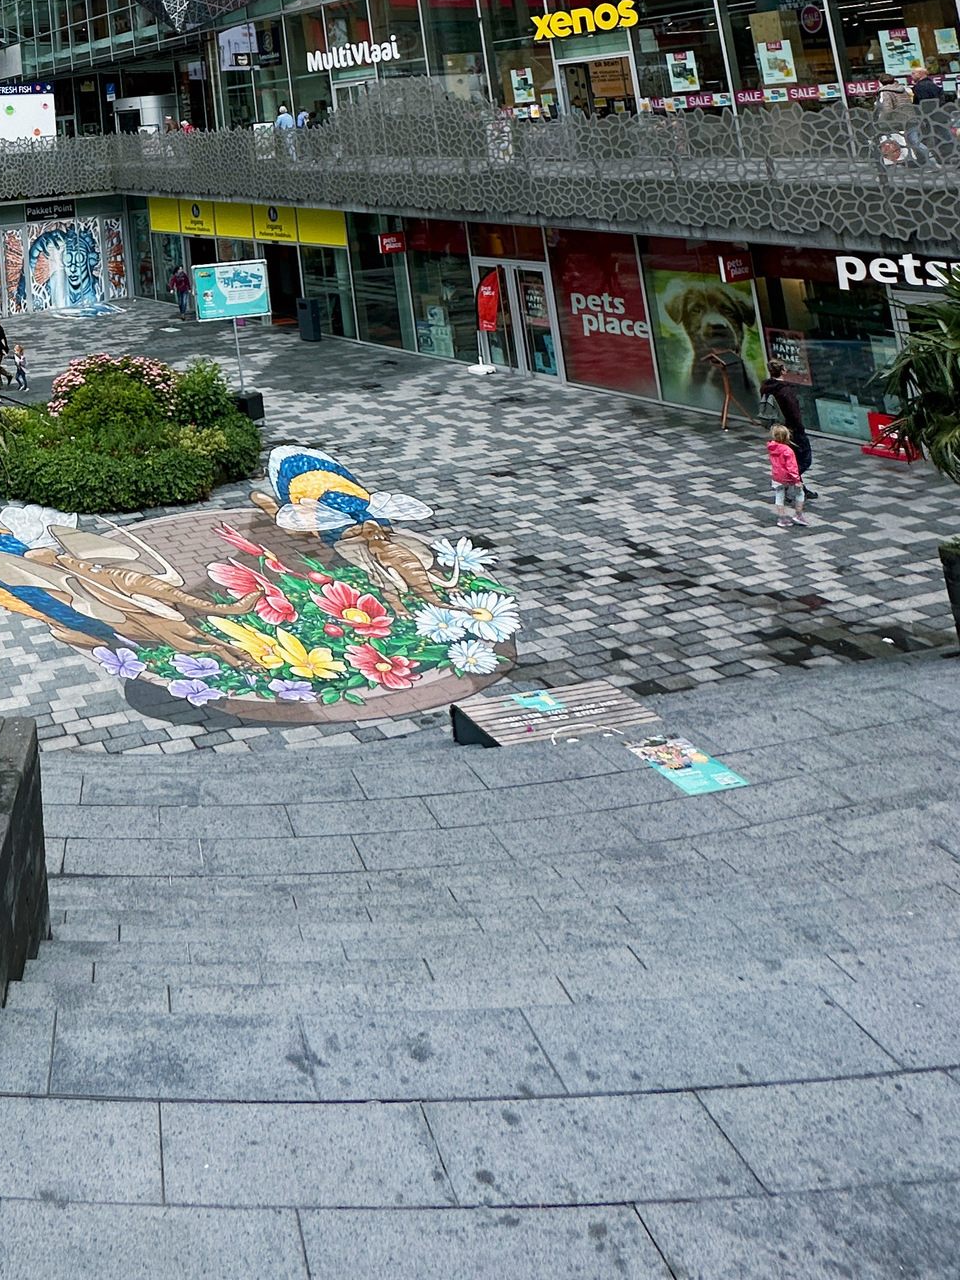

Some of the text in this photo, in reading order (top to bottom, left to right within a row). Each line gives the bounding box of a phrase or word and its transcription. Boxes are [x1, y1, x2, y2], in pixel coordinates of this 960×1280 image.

[530, 0, 639, 41] xenos
[306, 35, 400, 73] MultiVlaai
[19, 85, 32, 93] FISH
[791, 87, 816, 99] SALE
[847, 82, 877, 94] SALE
[689, 96, 710, 106] SALE
[737, 91, 761, 103] SALE
[27, 205, 73, 216] Pakket Point
[726, 258, 743, 270] pets
[730, 264, 750, 278] place
[570, 292, 626, 315] pets
[582, 313, 649, 338] place
[772, 343, 800, 355] HAPPY
[776, 353, 800, 363] PLACE
[574, 708, 607, 718] EFFECT
